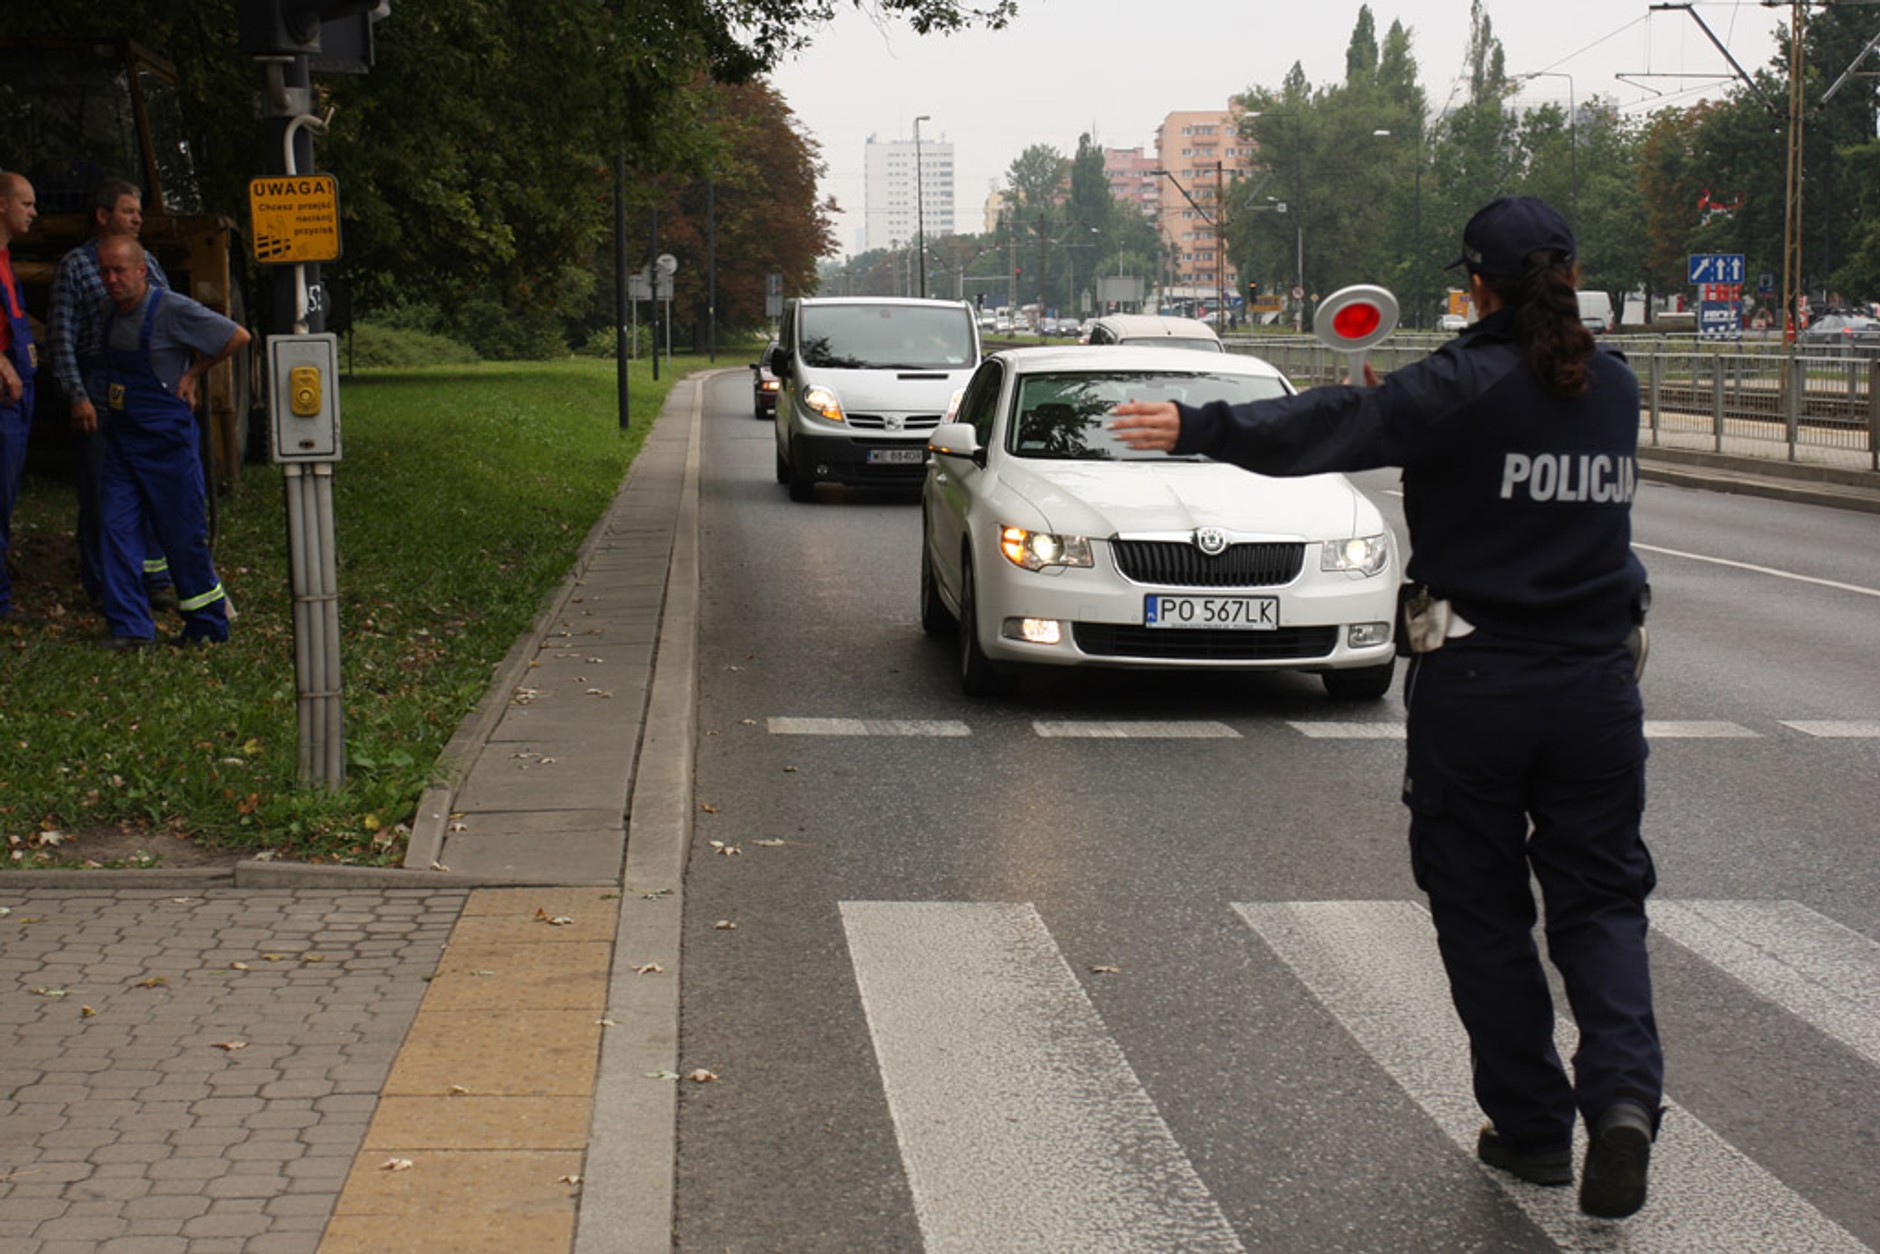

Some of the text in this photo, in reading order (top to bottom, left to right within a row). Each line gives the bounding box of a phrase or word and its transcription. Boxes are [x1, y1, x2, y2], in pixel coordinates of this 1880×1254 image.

[253, 181, 332, 197] UWAGA!
[258, 203, 293, 212] Chcesz
[1500, 453, 1635, 503] POLICJA
[1160, 598, 1273, 623] PO 567LK
